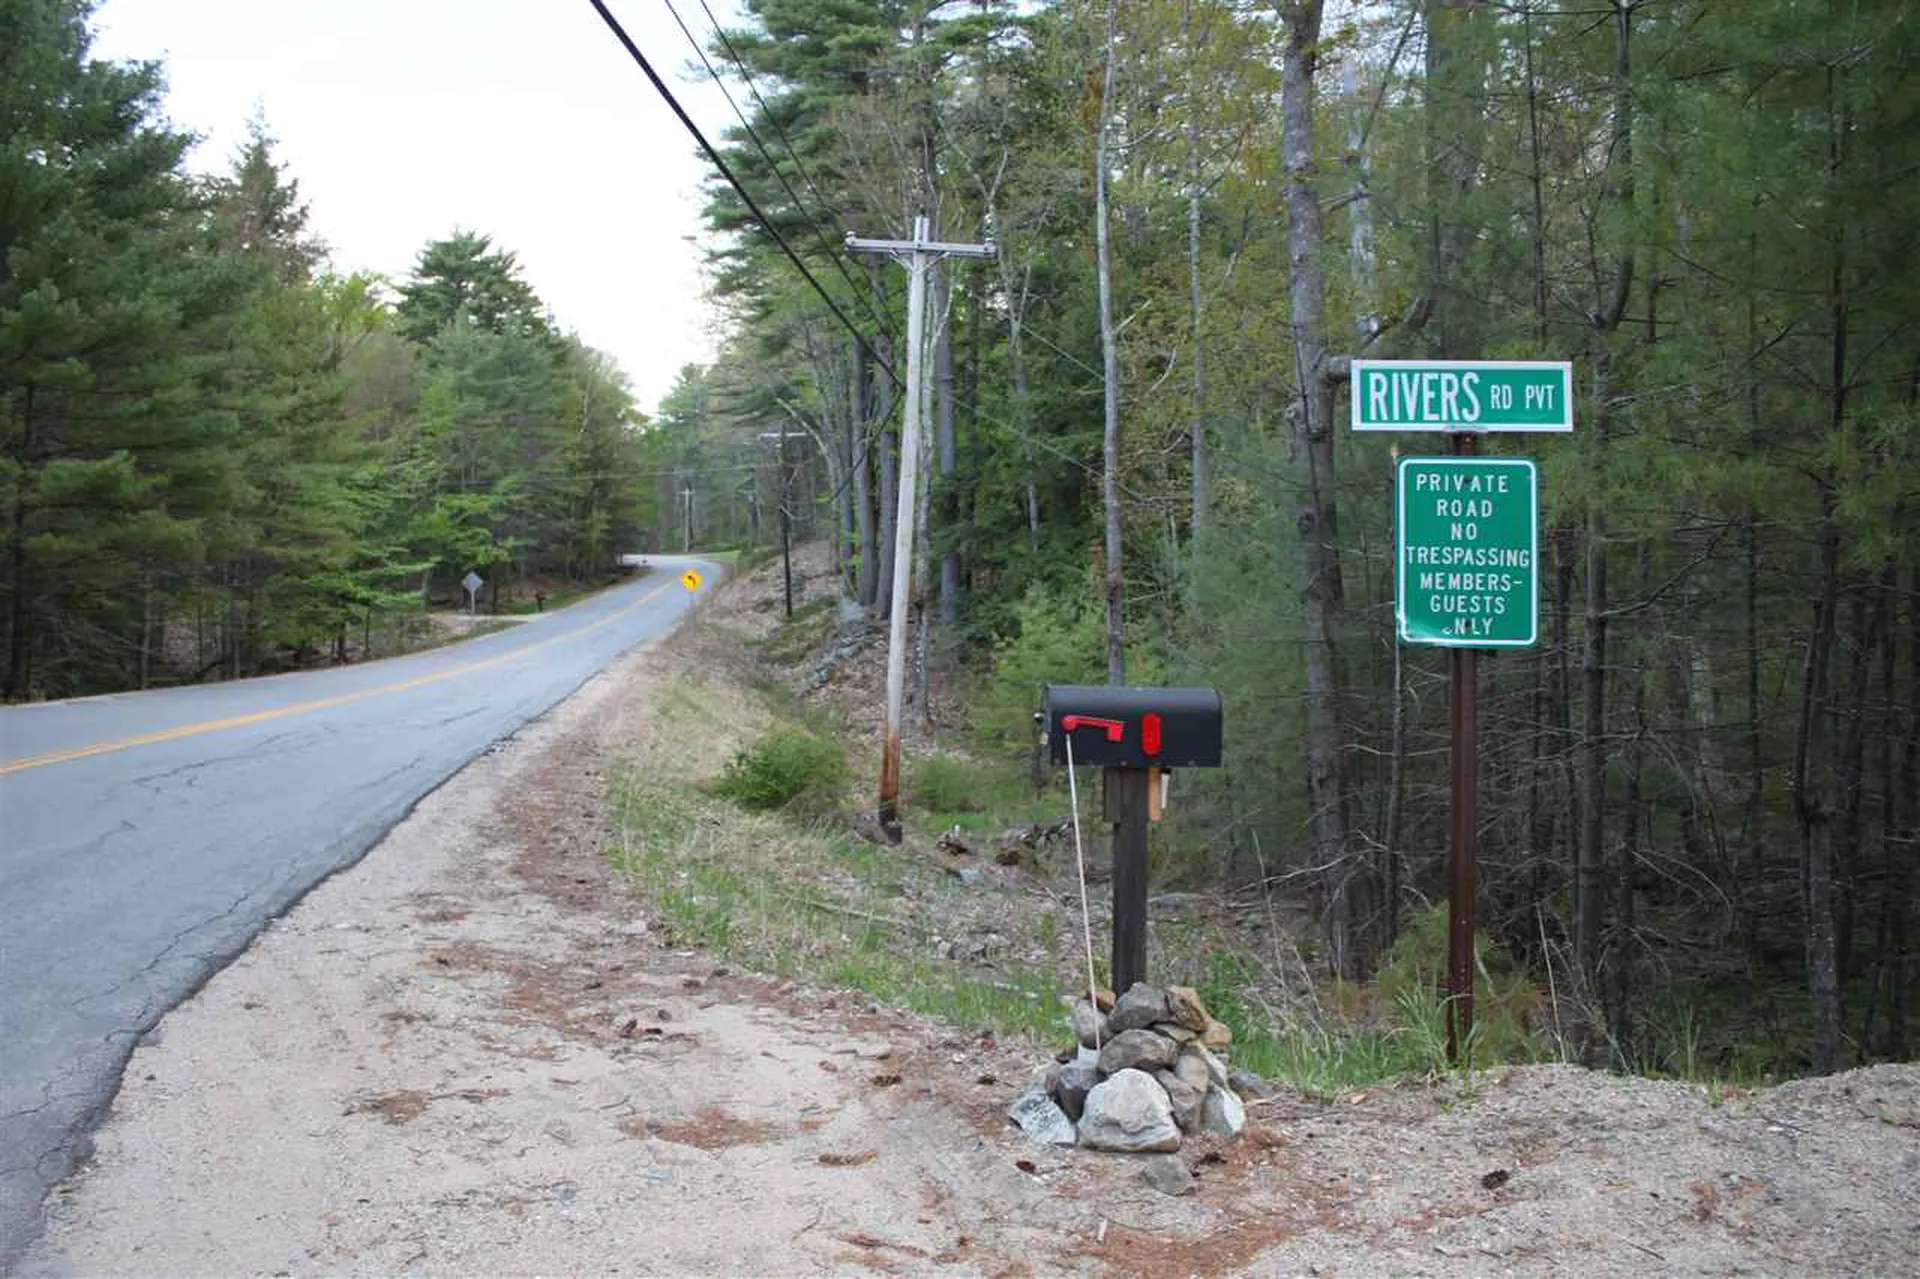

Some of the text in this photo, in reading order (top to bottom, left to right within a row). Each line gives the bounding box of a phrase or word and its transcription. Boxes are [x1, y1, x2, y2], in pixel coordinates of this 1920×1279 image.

[1368, 372, 1555, 422] RIVERS RD PVT
[1416, 474, 1509, 493] PRIVATE
[1436, 499, 1493, 517] ROAD
[1451, 523, 1477, 540] NO
[1406, 546, 1530, 568] TRESPASSING
[1420, 573, 1523, 592] MEMBERS-
[1430, 595, 1506, 614] GUESTS
[1442, 618, 1493, 635] NLY
